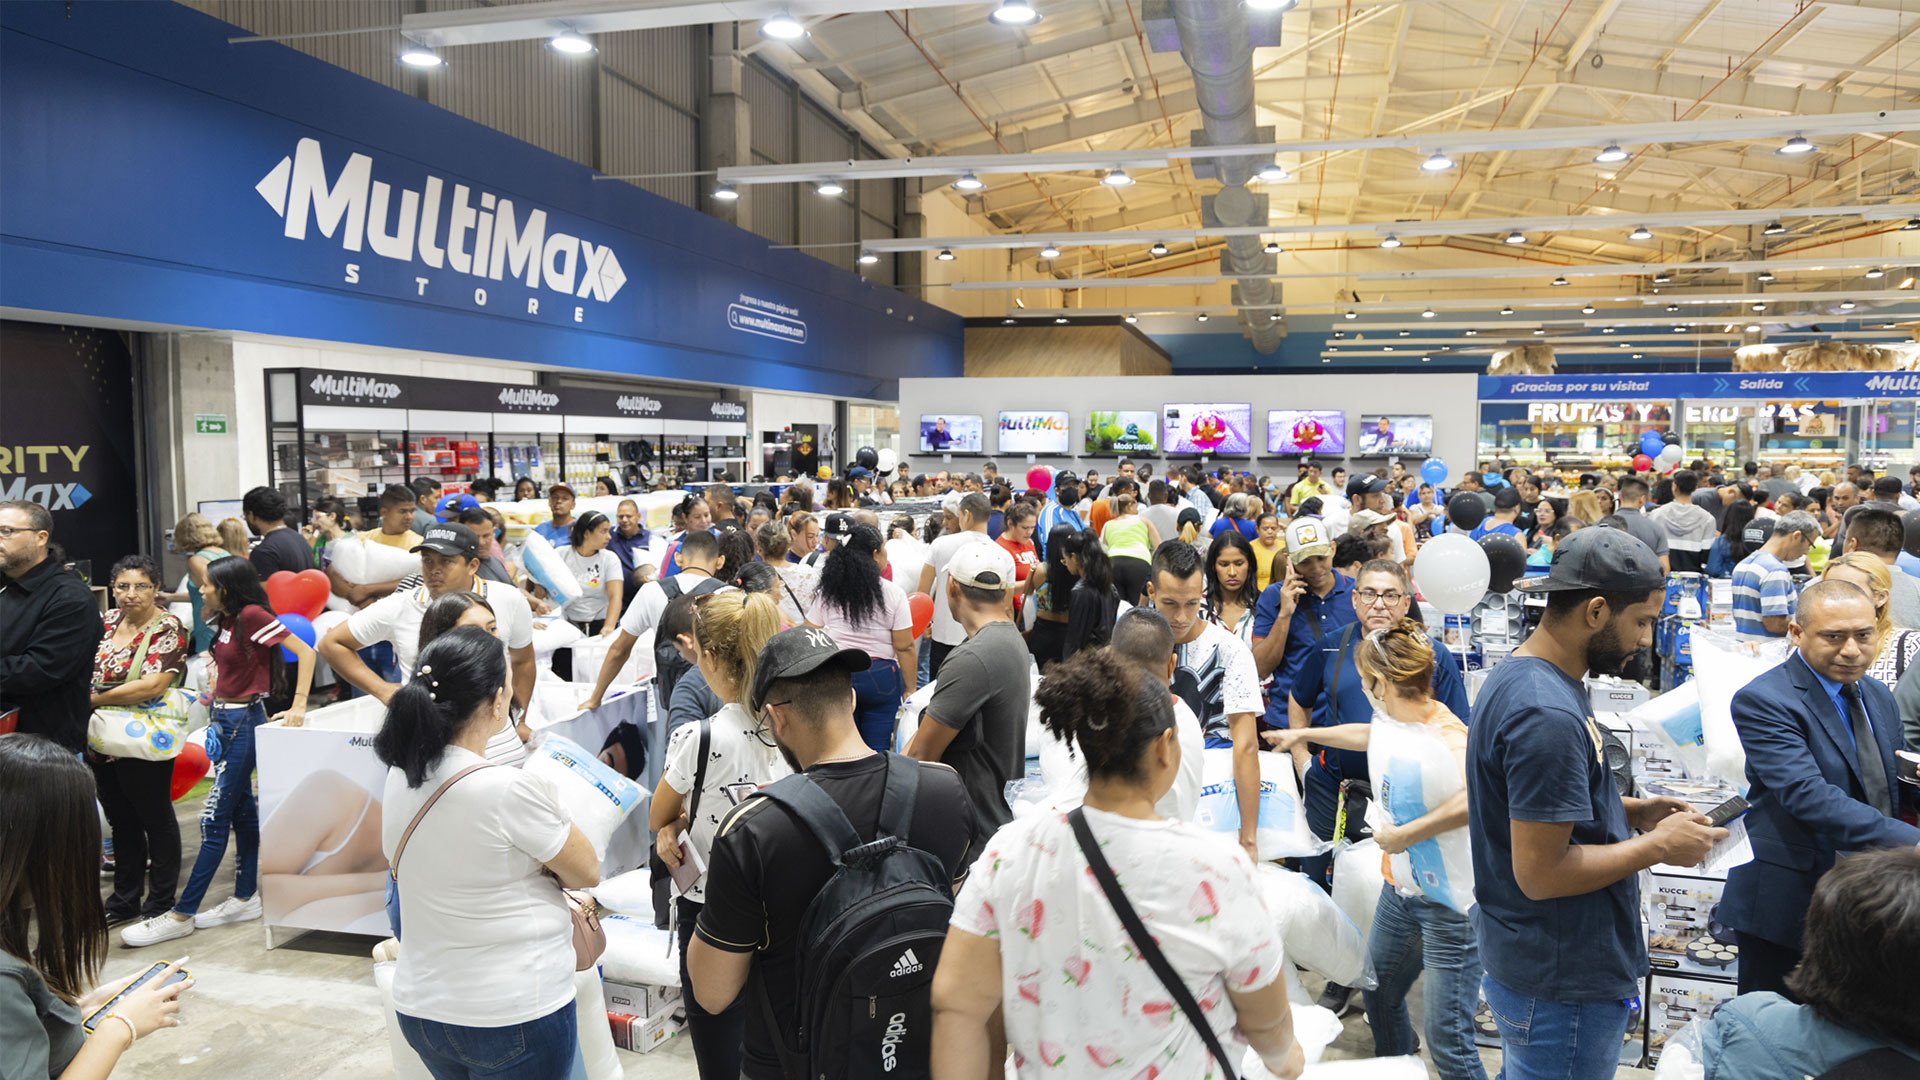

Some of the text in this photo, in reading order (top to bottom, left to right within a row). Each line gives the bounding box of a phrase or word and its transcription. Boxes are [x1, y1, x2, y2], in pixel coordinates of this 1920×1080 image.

[285, 137, 615, 303] MultiMax
[344, 263, 584, 322] STORE
[739, 315, 804, 337] www.multimaxstore.com
[314, 374, 393, 399] MultiMax
[1511, 381, 1650, 394] ¡Gracias por su visita!
[1739, 378, 1784, 390] Salida
[501, 388, 553, 407] MultiMax
[1528, 403, 1625, 423] FRUTAS
[1636, 403, 1653, 422] Y
[1113, 442, 1154, 450] Modo tienda
[351, 736, 374, 747] Mul
[1658, 887, 1688, 896] KUCCE
[890, 963, 923, 978] adidas
[1660, 987, 1690, 996] KUCCE
[881, 1012, 908, 1072] adidas
